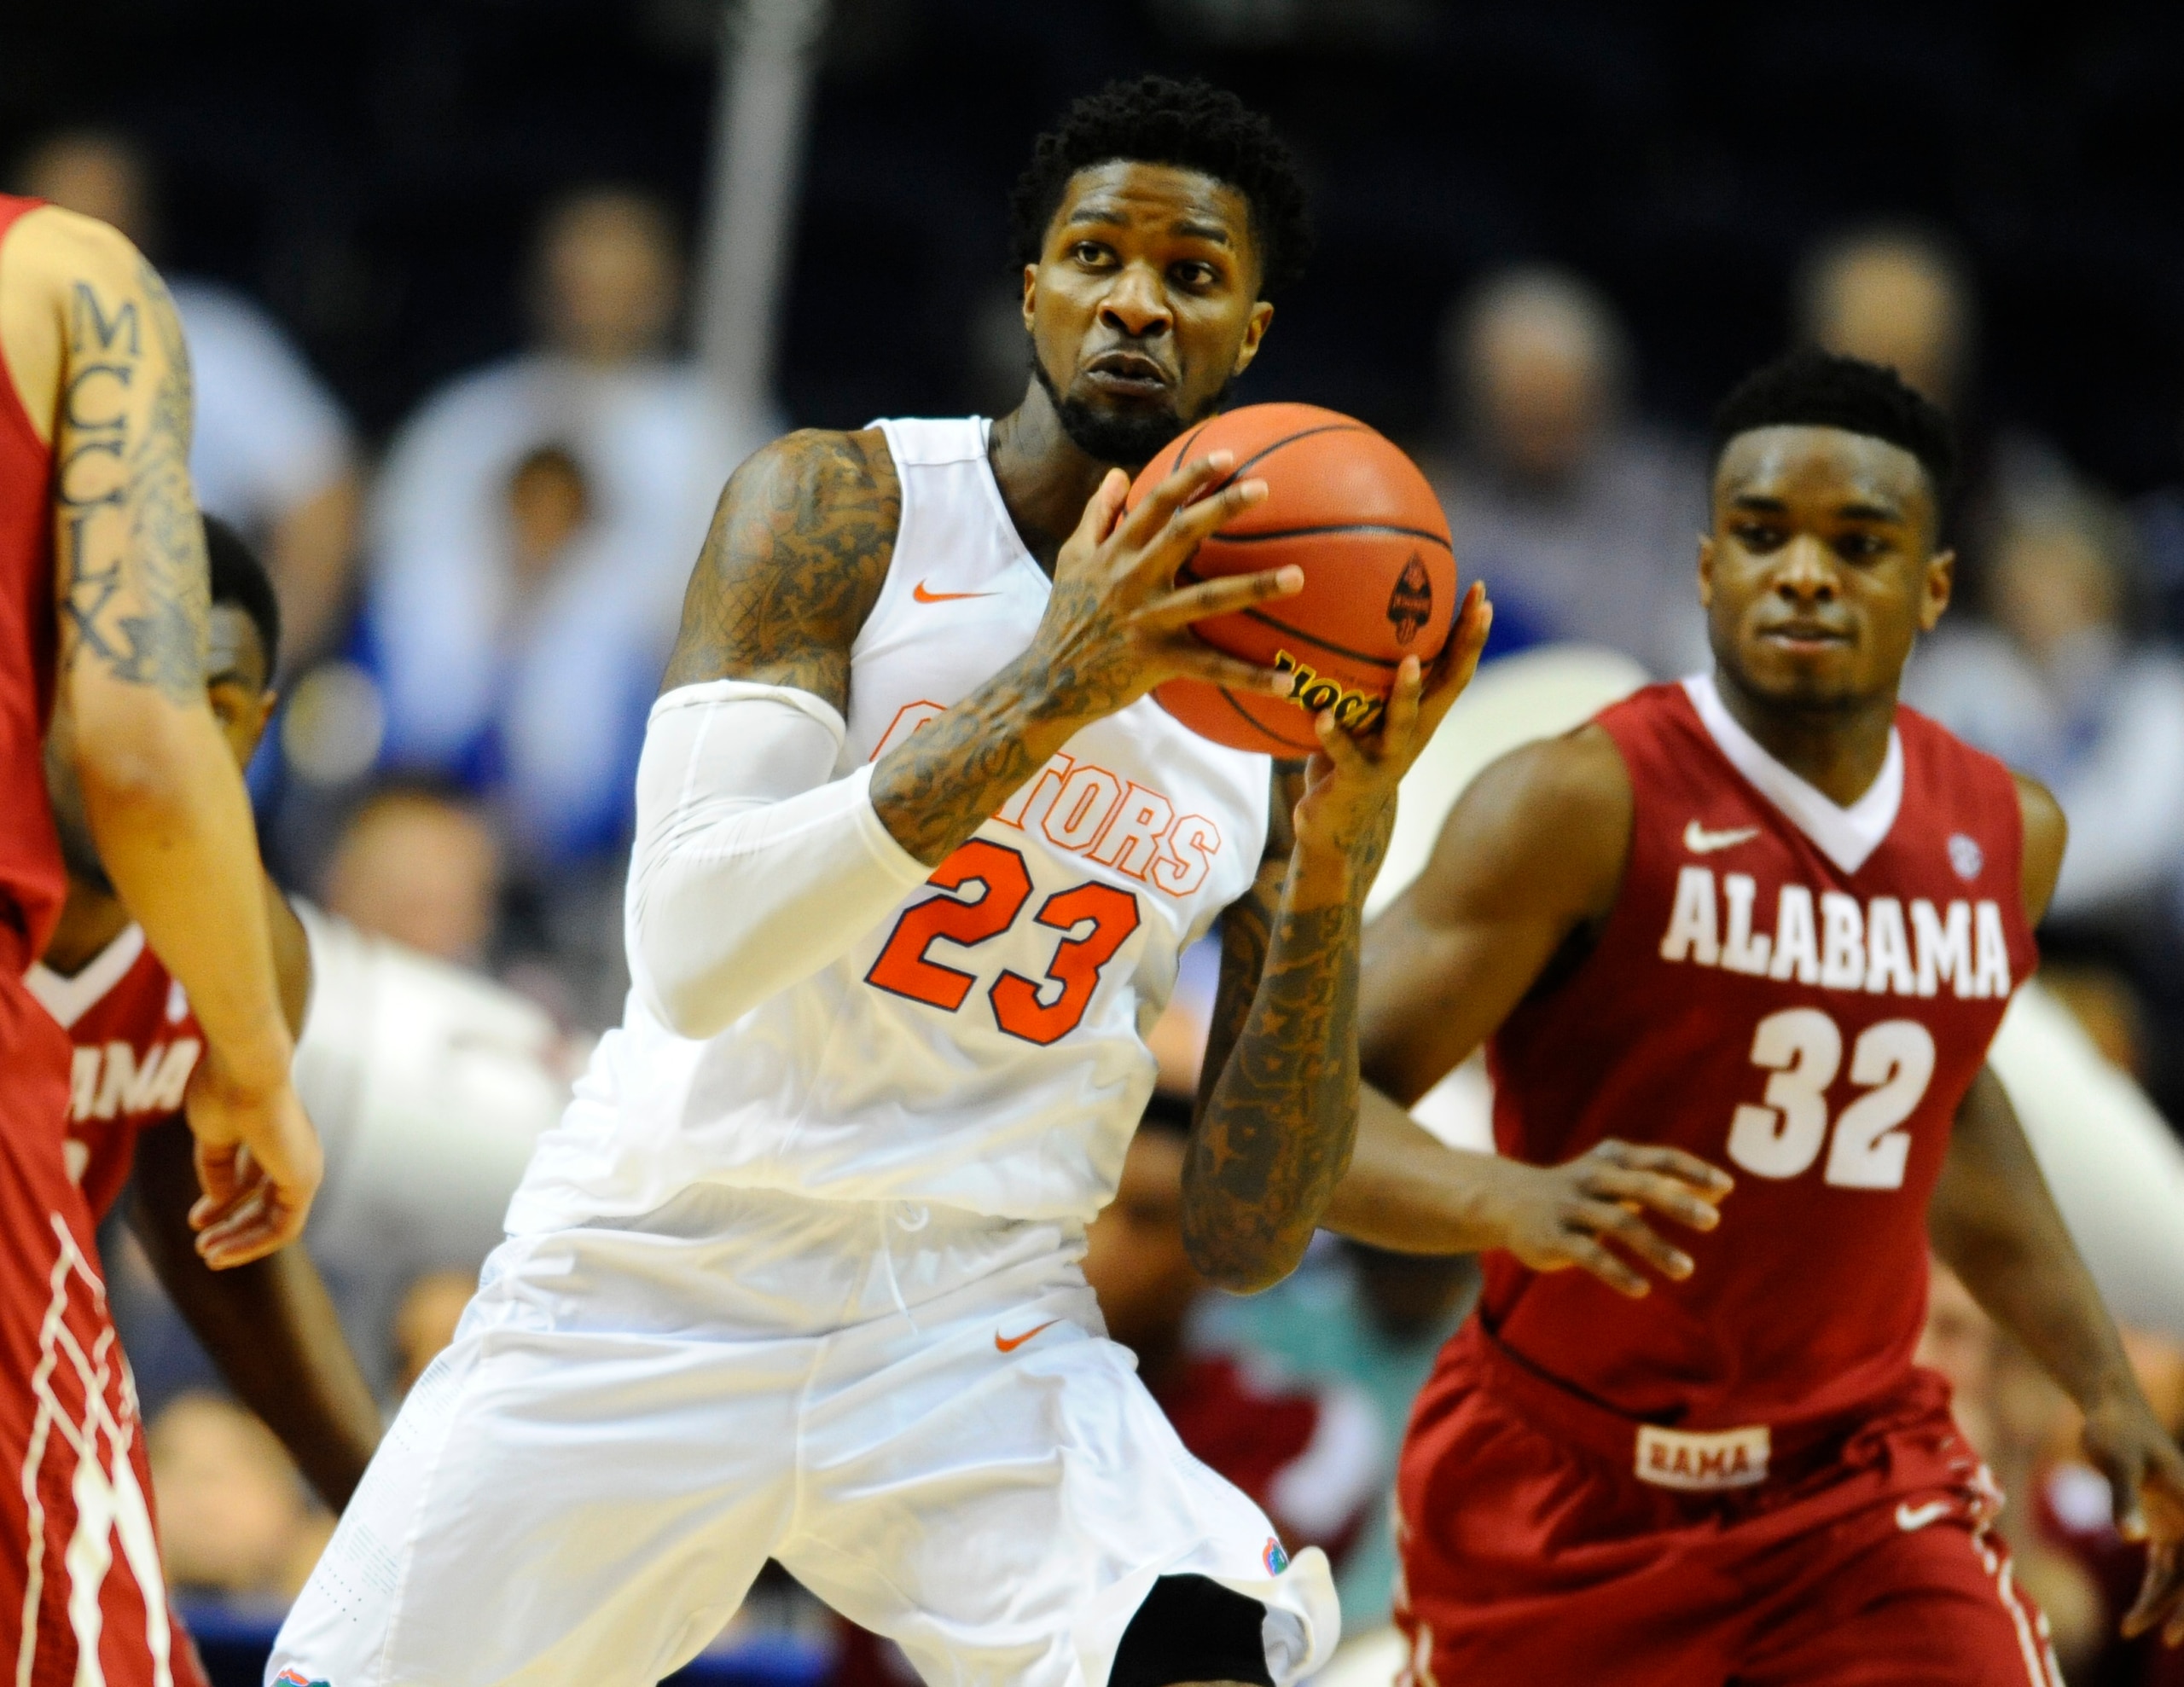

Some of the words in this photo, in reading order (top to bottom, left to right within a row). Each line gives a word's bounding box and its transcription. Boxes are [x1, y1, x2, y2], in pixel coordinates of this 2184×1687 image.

[868, 699, 1222, 899] TORS
[864, 837, 1141, 1046] 23
[1659, 864, 2012, 1000] ALABAMA
[1726, 1006, 1937, 1190] 32
